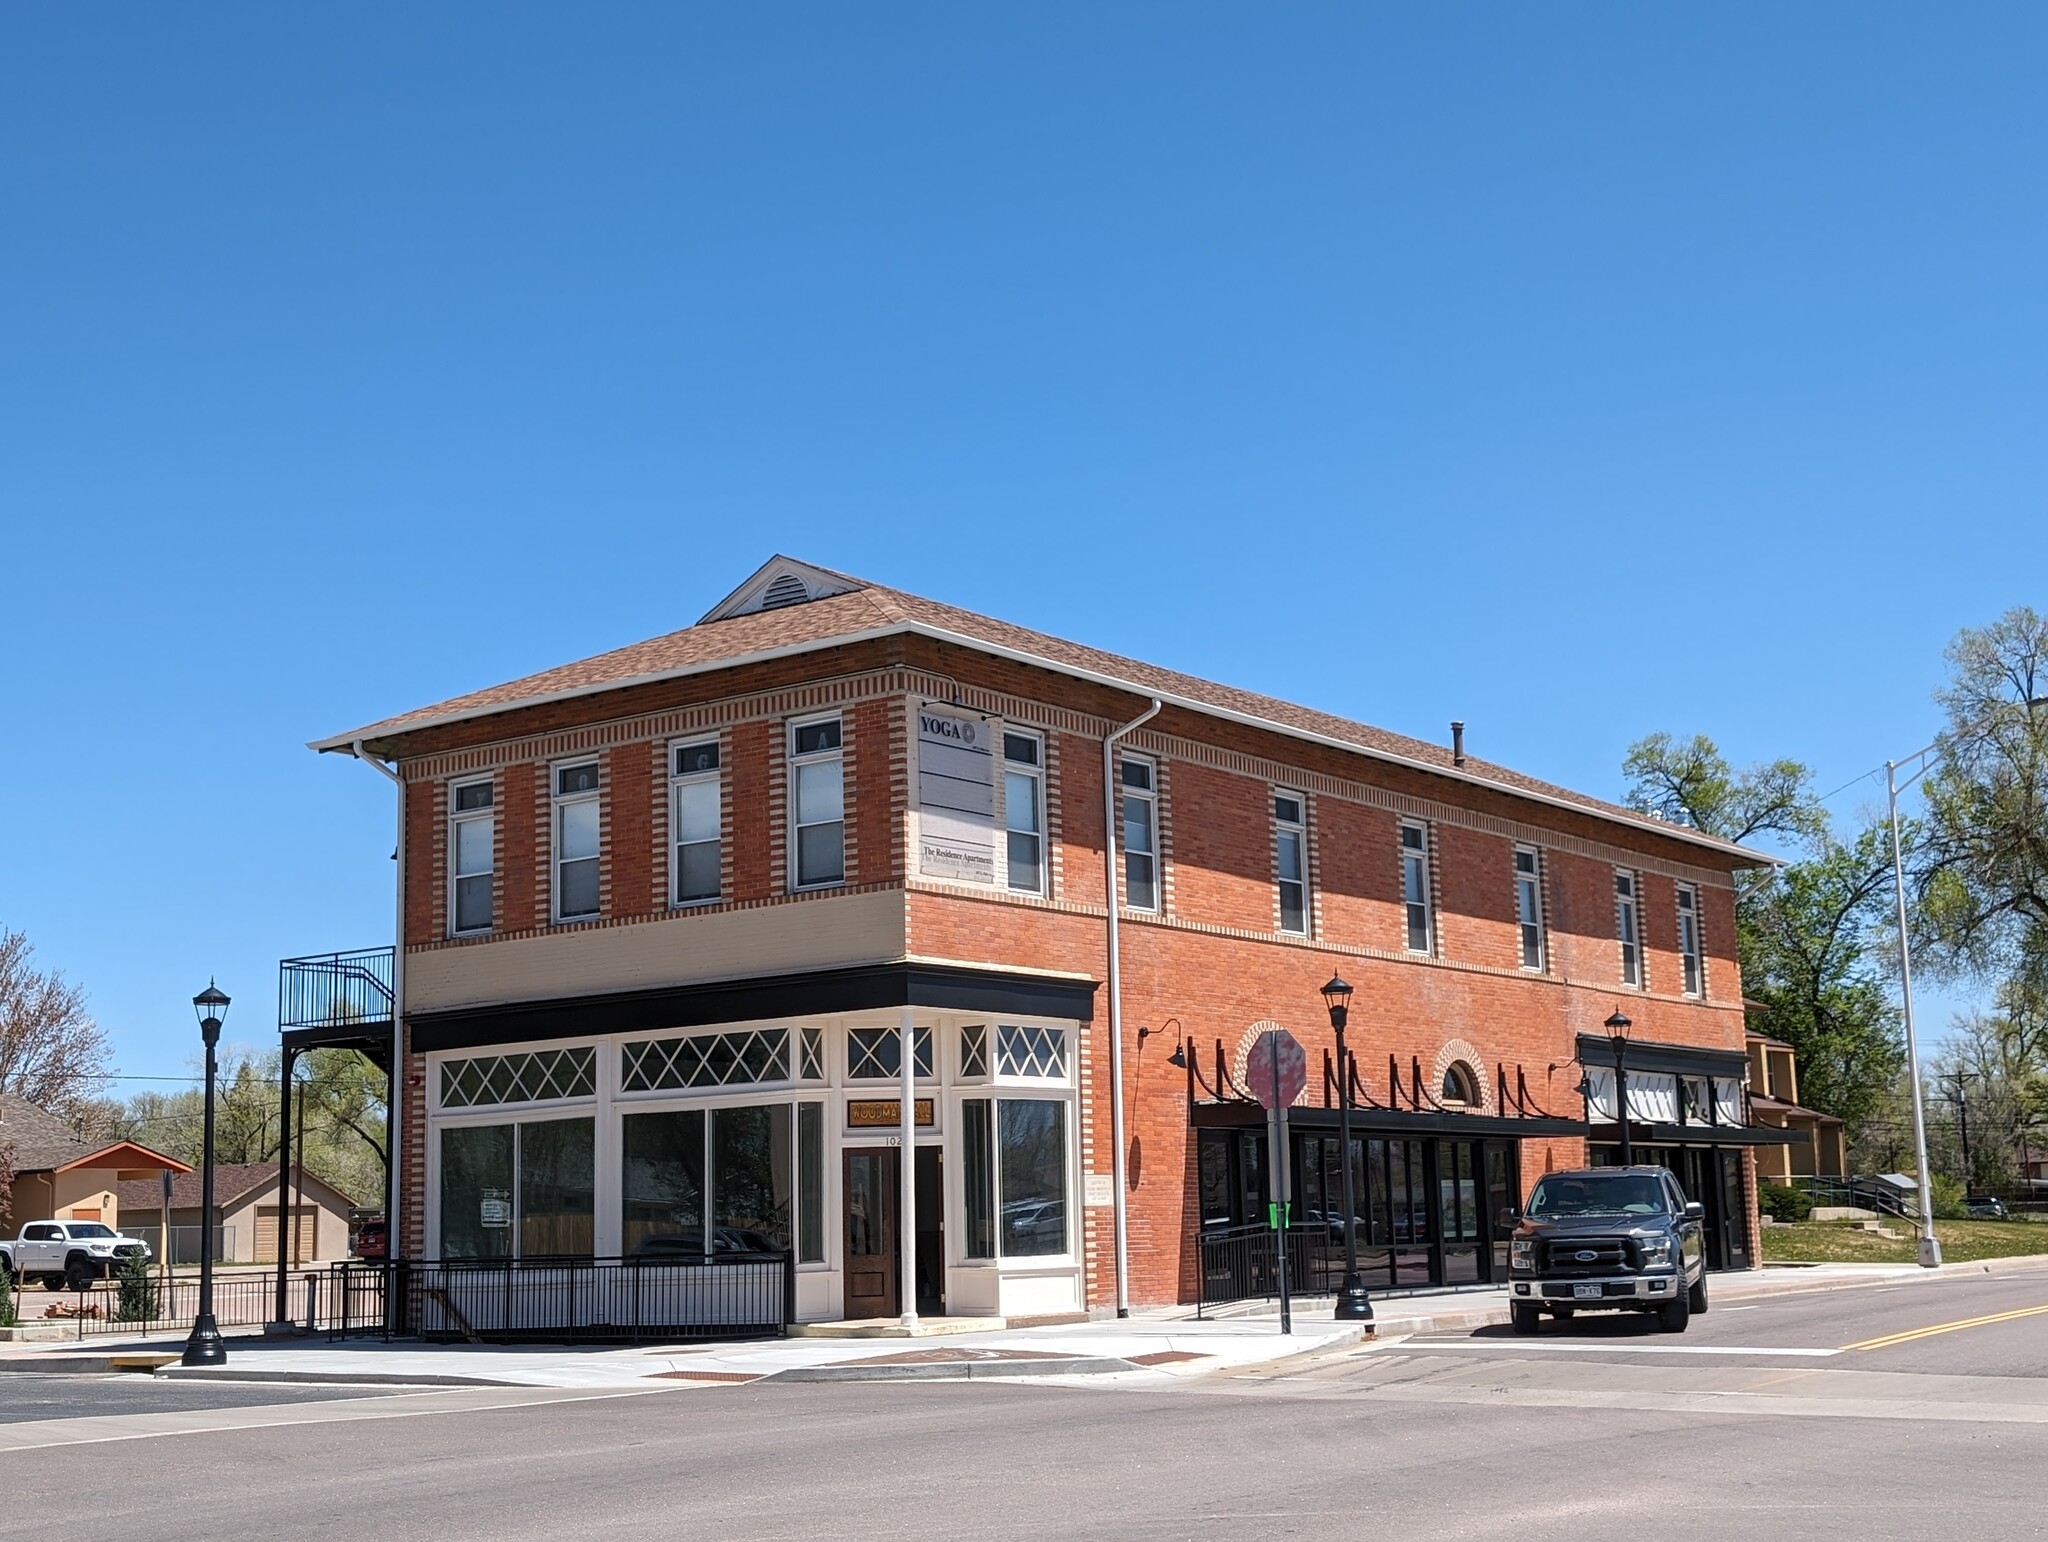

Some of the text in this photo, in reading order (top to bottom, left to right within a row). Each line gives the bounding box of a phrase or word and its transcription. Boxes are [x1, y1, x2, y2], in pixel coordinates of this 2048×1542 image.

[921, 716, 961, 739] YOGA
[924, 846, 994, 865] The Residence Apartments
[885, 1137, 902, 1146] 102
